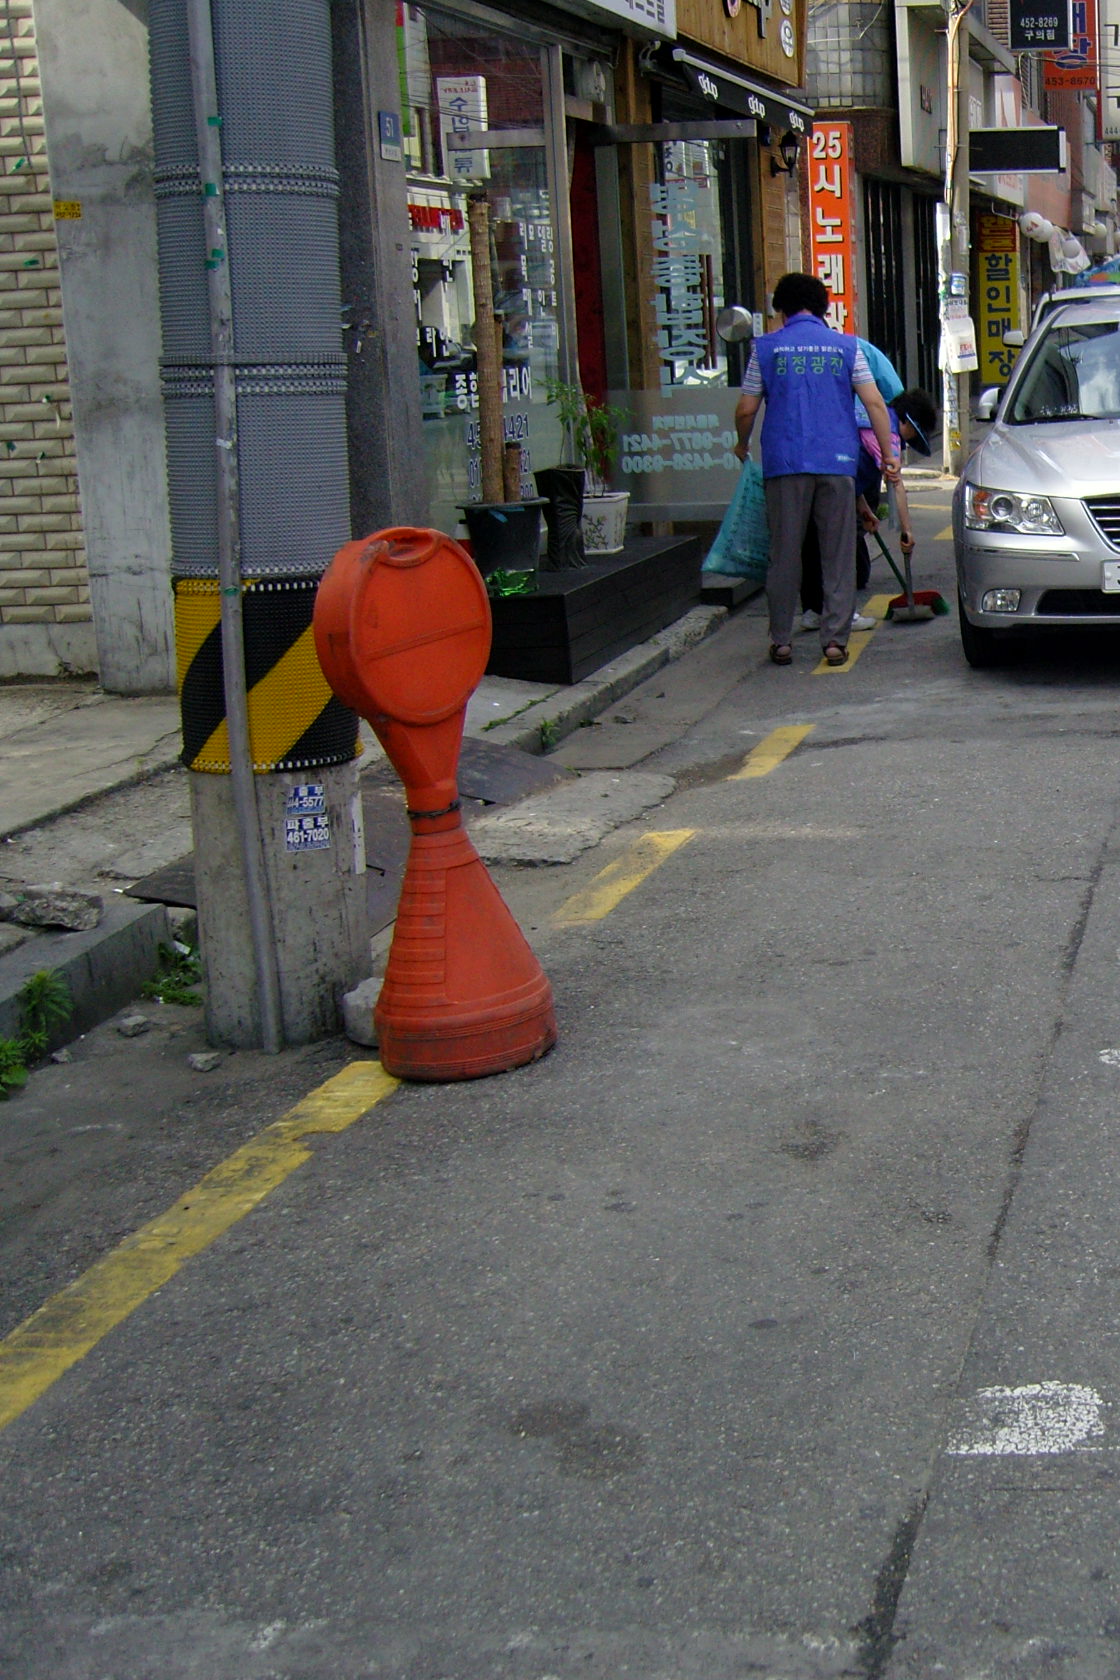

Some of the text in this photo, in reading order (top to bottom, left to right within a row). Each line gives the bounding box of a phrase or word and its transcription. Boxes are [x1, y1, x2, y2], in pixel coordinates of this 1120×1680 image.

[985, 253, 1016, 377] 할인매장
[776, 355, 843, 376] 청정광진
[287, 829, 330, 844] 461-7020
